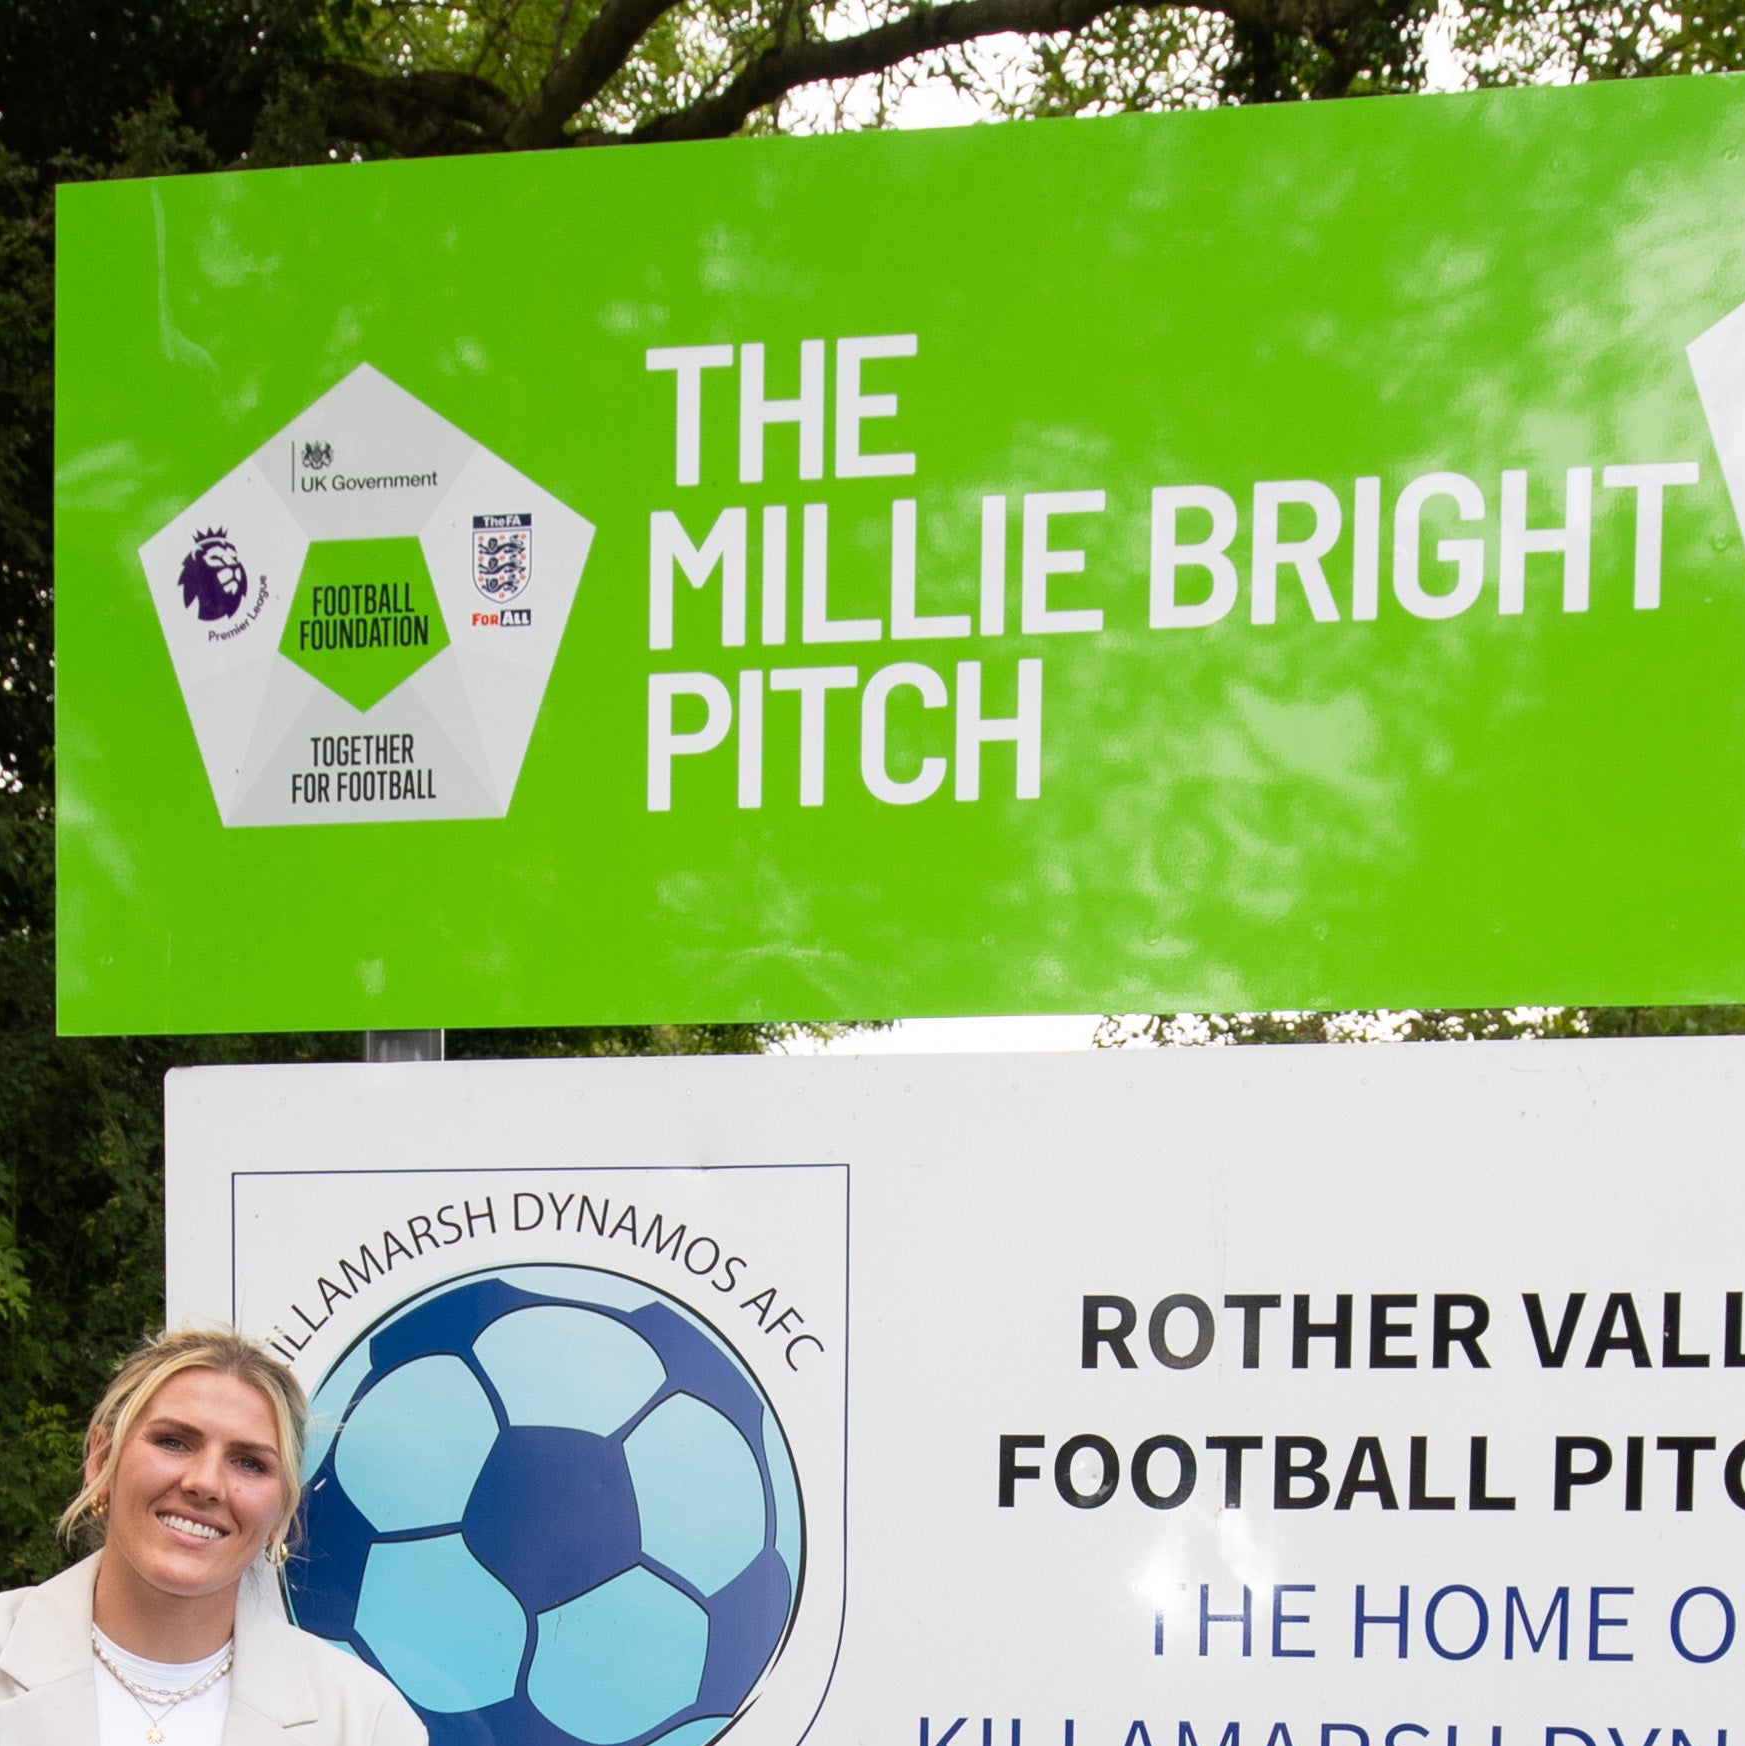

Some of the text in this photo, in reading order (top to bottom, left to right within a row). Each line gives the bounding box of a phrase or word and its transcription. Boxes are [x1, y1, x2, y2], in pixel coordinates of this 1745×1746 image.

[646, 334, 918, 486] THE
[301, 470, 438, 492] UK Government
[649, 461, 1700, 649] MILLIE BRIGHT
[208, 574, 270, 642] Premier League
[300, 615, 429, 651] FOUNDATION
[312, 582, 415, 617] FOOTBALL
[310, 733, 415, 767] TOGETHER
[647, 658, 1043, 811] PITCH
[292, 768, 437, 804] FOR FOOTBALL
[265, 1192, 825, 1372] ILLAMARSH DYNAMOS AFC
[1080, 1293, 1492, 1370] ROTHER
[997, 1433, 1516, 1511] FOOTBALL
[1353, 1584, 1634, 1662] HOME
